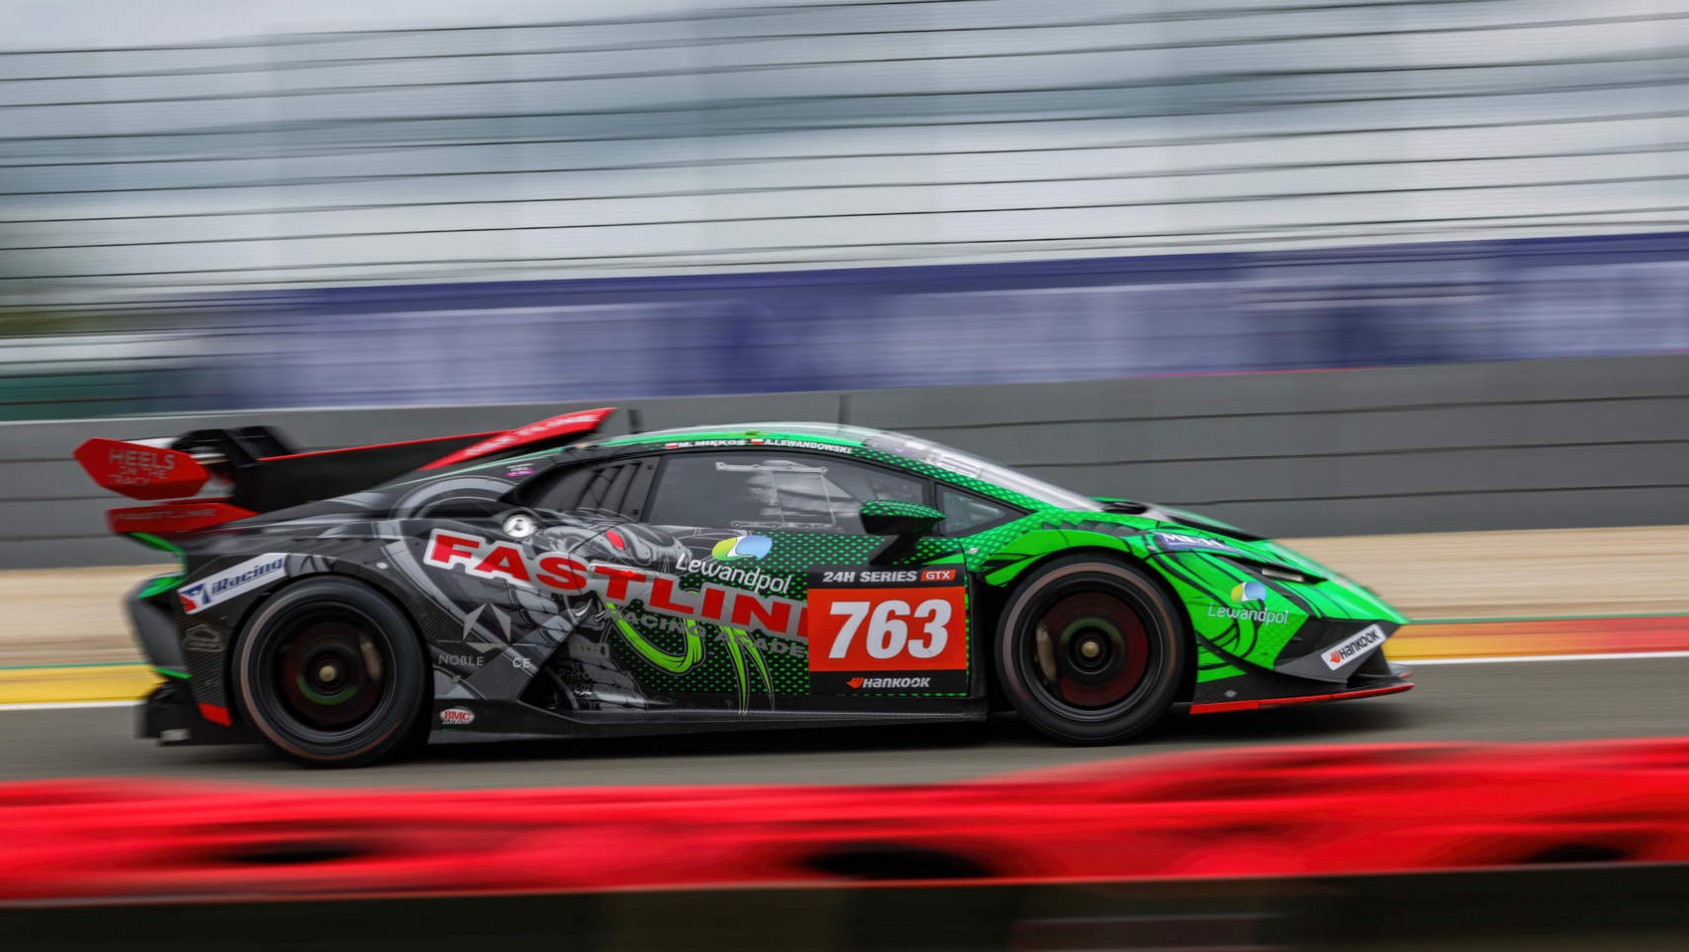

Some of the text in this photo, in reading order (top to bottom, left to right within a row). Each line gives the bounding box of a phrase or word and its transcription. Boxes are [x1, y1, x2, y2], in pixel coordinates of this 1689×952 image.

[108, 449, 175, 470] HEELS
[146, 469, 167, 479] THE
[675, 553, 792, 594] Lewandpol
[822, 571, 918, 583] 24H SERIES
[925, 570, 951, 581] GTX
[426, 530, 808, 639] FASTLIN
[1207, 602, 1289, 626] Lewandpol
[828, 599, 952, 660] 763
[714, 631, 807, 659] ACADE
[438, 655, 484, 667] NOBLE
[444, 711, 470, 721] BMC
